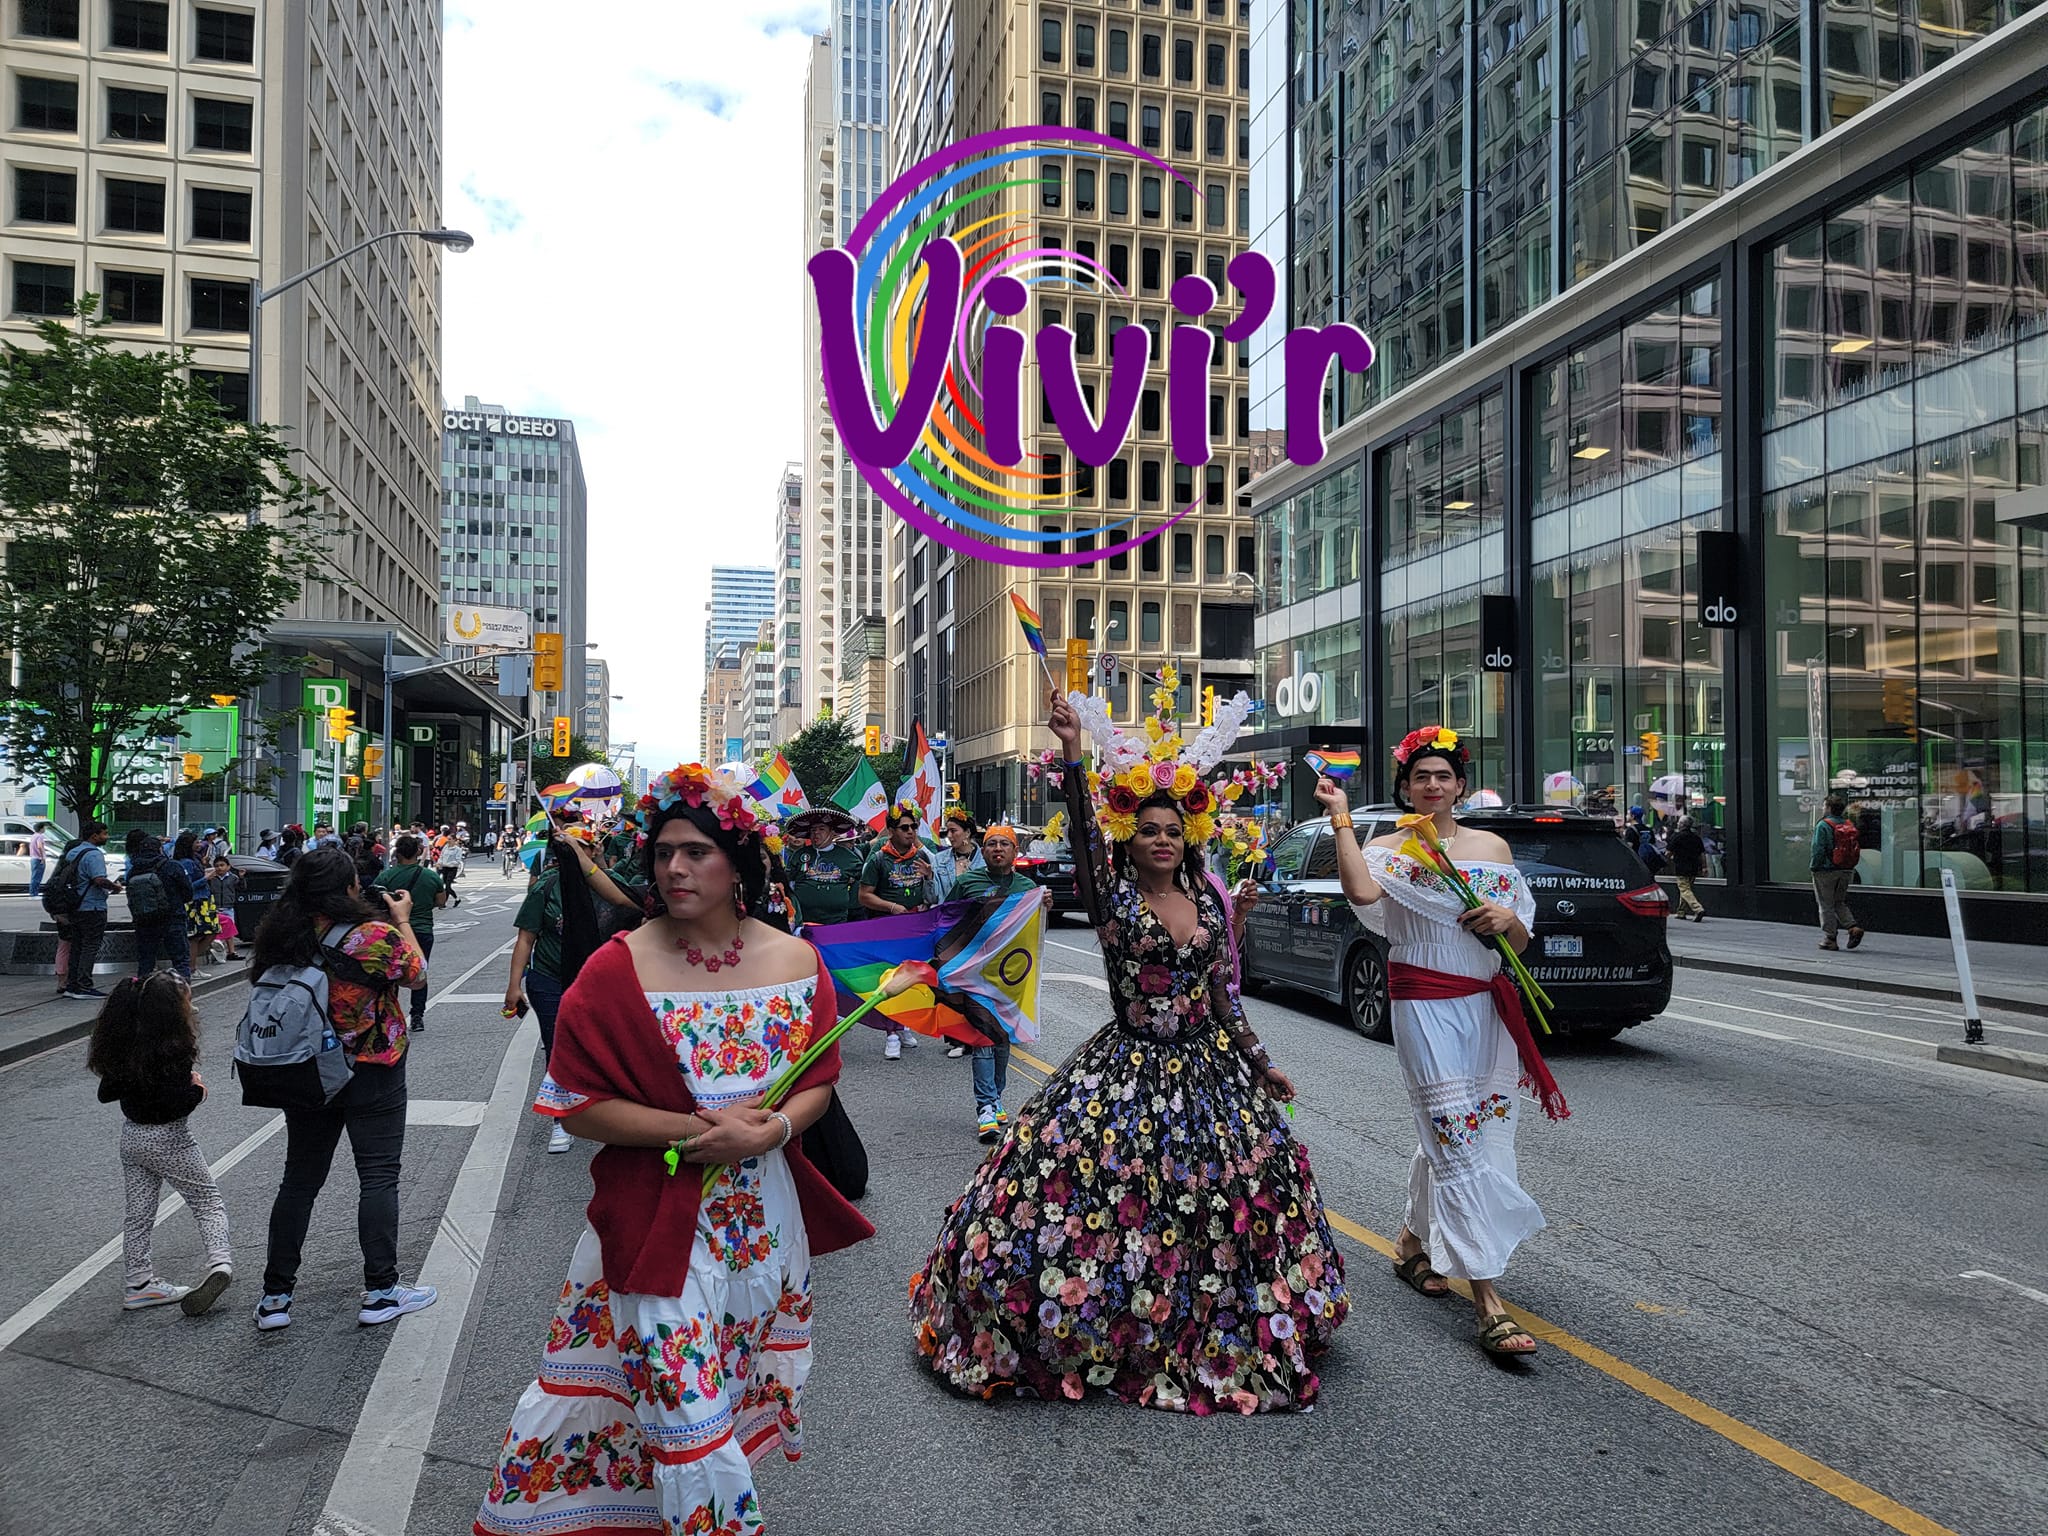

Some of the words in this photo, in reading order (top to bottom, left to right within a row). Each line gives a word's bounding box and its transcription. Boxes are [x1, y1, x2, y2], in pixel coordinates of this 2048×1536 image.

[443, 415, 483, 431] OCT
[504, 420, 557, 437] OEEO
[1704, 596, 1737, 622] alo
[1485, 646, 1512, 667] alo
[1276, 650, 1321, 717] alo
[307, 684, 342, 707] TD
[409, 726, 433, 742] TD
[434, 789, 479, 797] SEPHORA
[1565, 877, 1625, 889] 647-786-2823
[250, 1022, 278, 1039] PUMA
